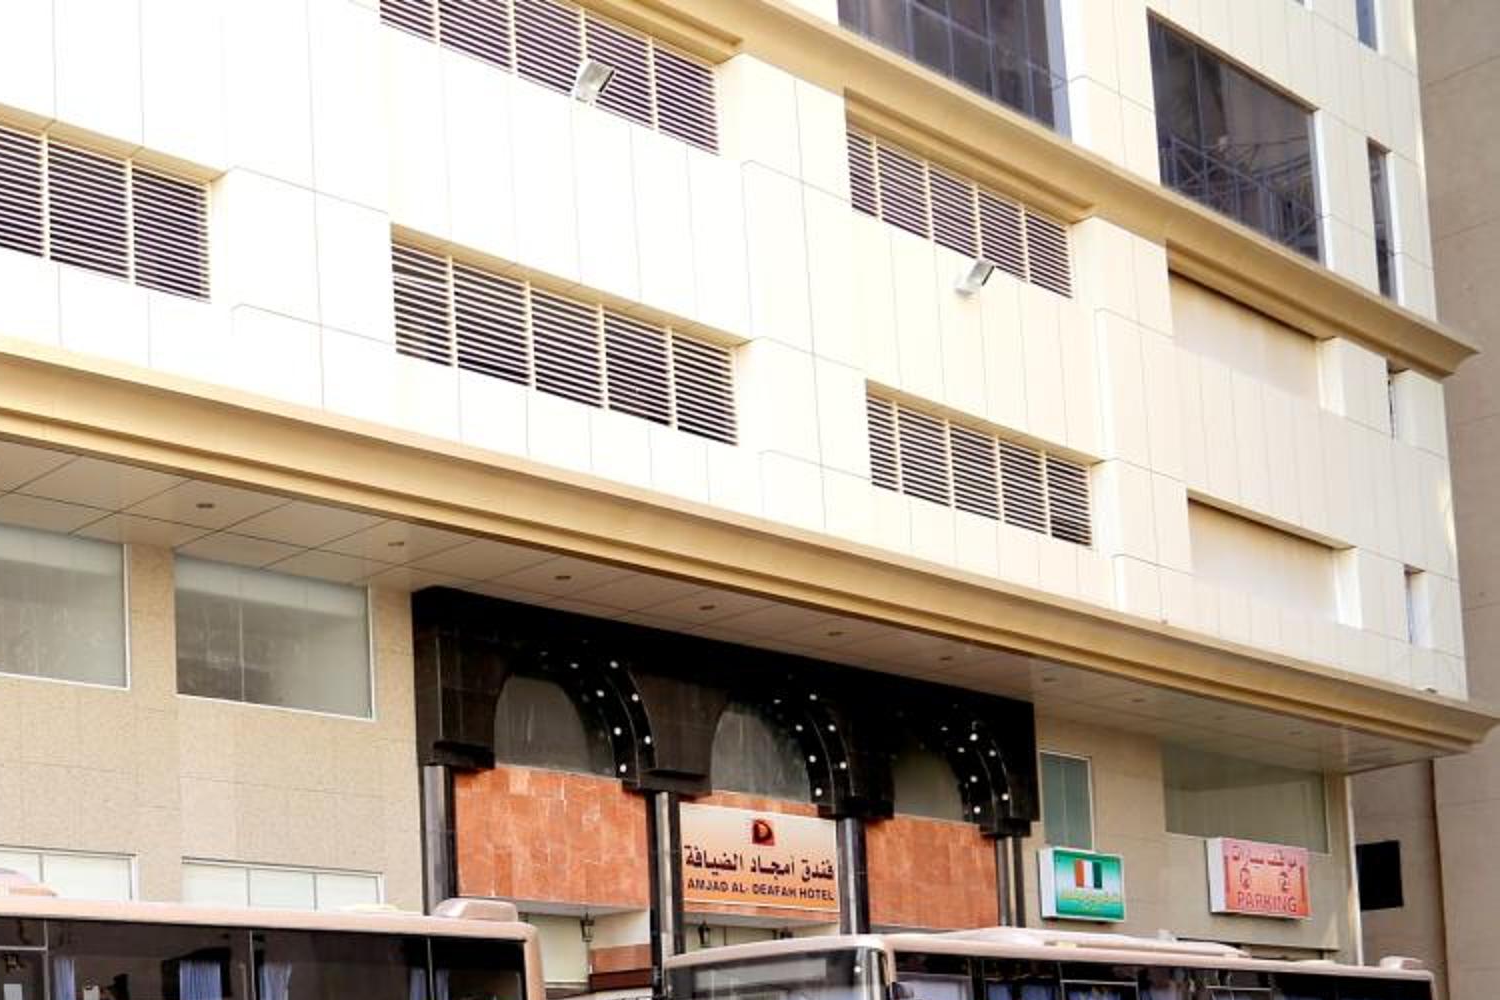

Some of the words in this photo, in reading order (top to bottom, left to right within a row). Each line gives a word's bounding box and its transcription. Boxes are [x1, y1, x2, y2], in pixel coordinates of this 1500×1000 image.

[684, 845, 743, 876] الضيافة
[801, 858, 835, 882] فندق
[687, 878, 729, 892] AMJAD
[752, 883, 797, 898] DEAFAH
[799, 888, 835, 901] HOTEL
[1237, 891, 1297, 912] PARKING
